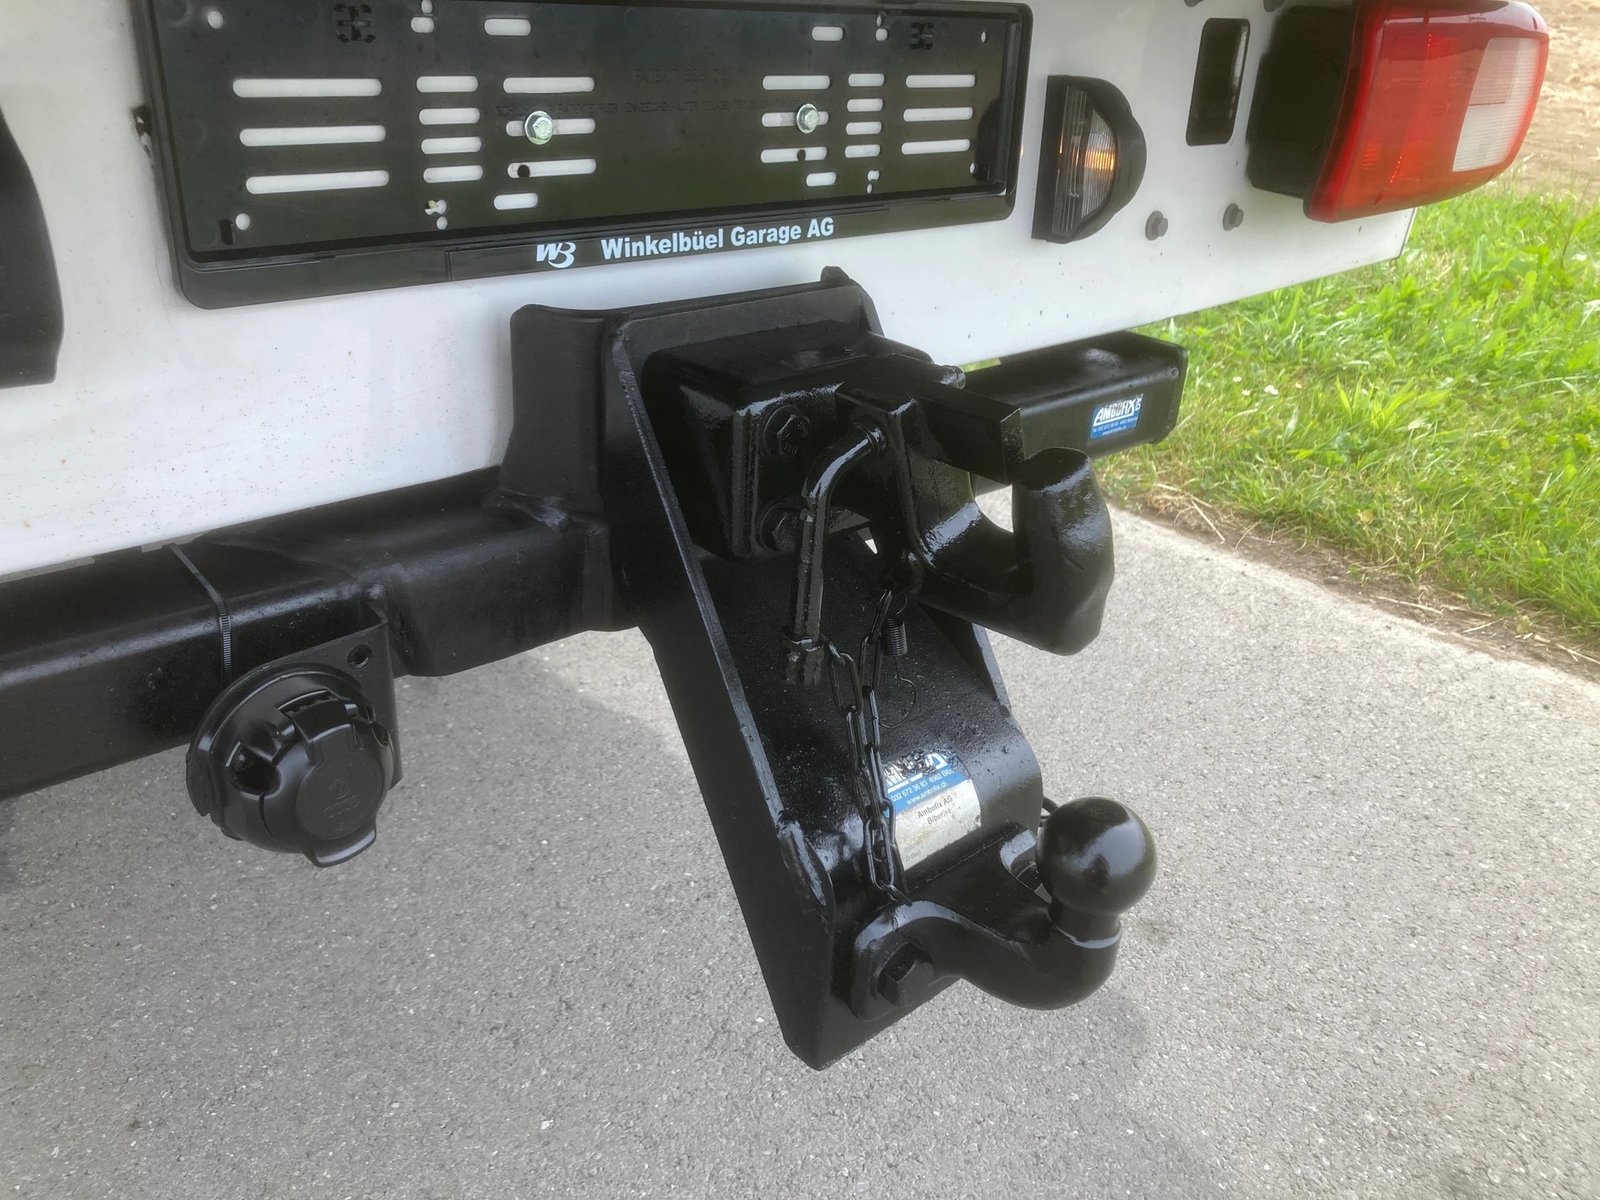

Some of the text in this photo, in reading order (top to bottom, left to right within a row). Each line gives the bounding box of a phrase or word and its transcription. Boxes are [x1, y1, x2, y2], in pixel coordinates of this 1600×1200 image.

[601, 229, 724, 260] Winkelbüel
[730, 225, 802, 247] Garage
[807, 217, 834, 238] AG
[916, 794, 954, 819] Ambofix AG
